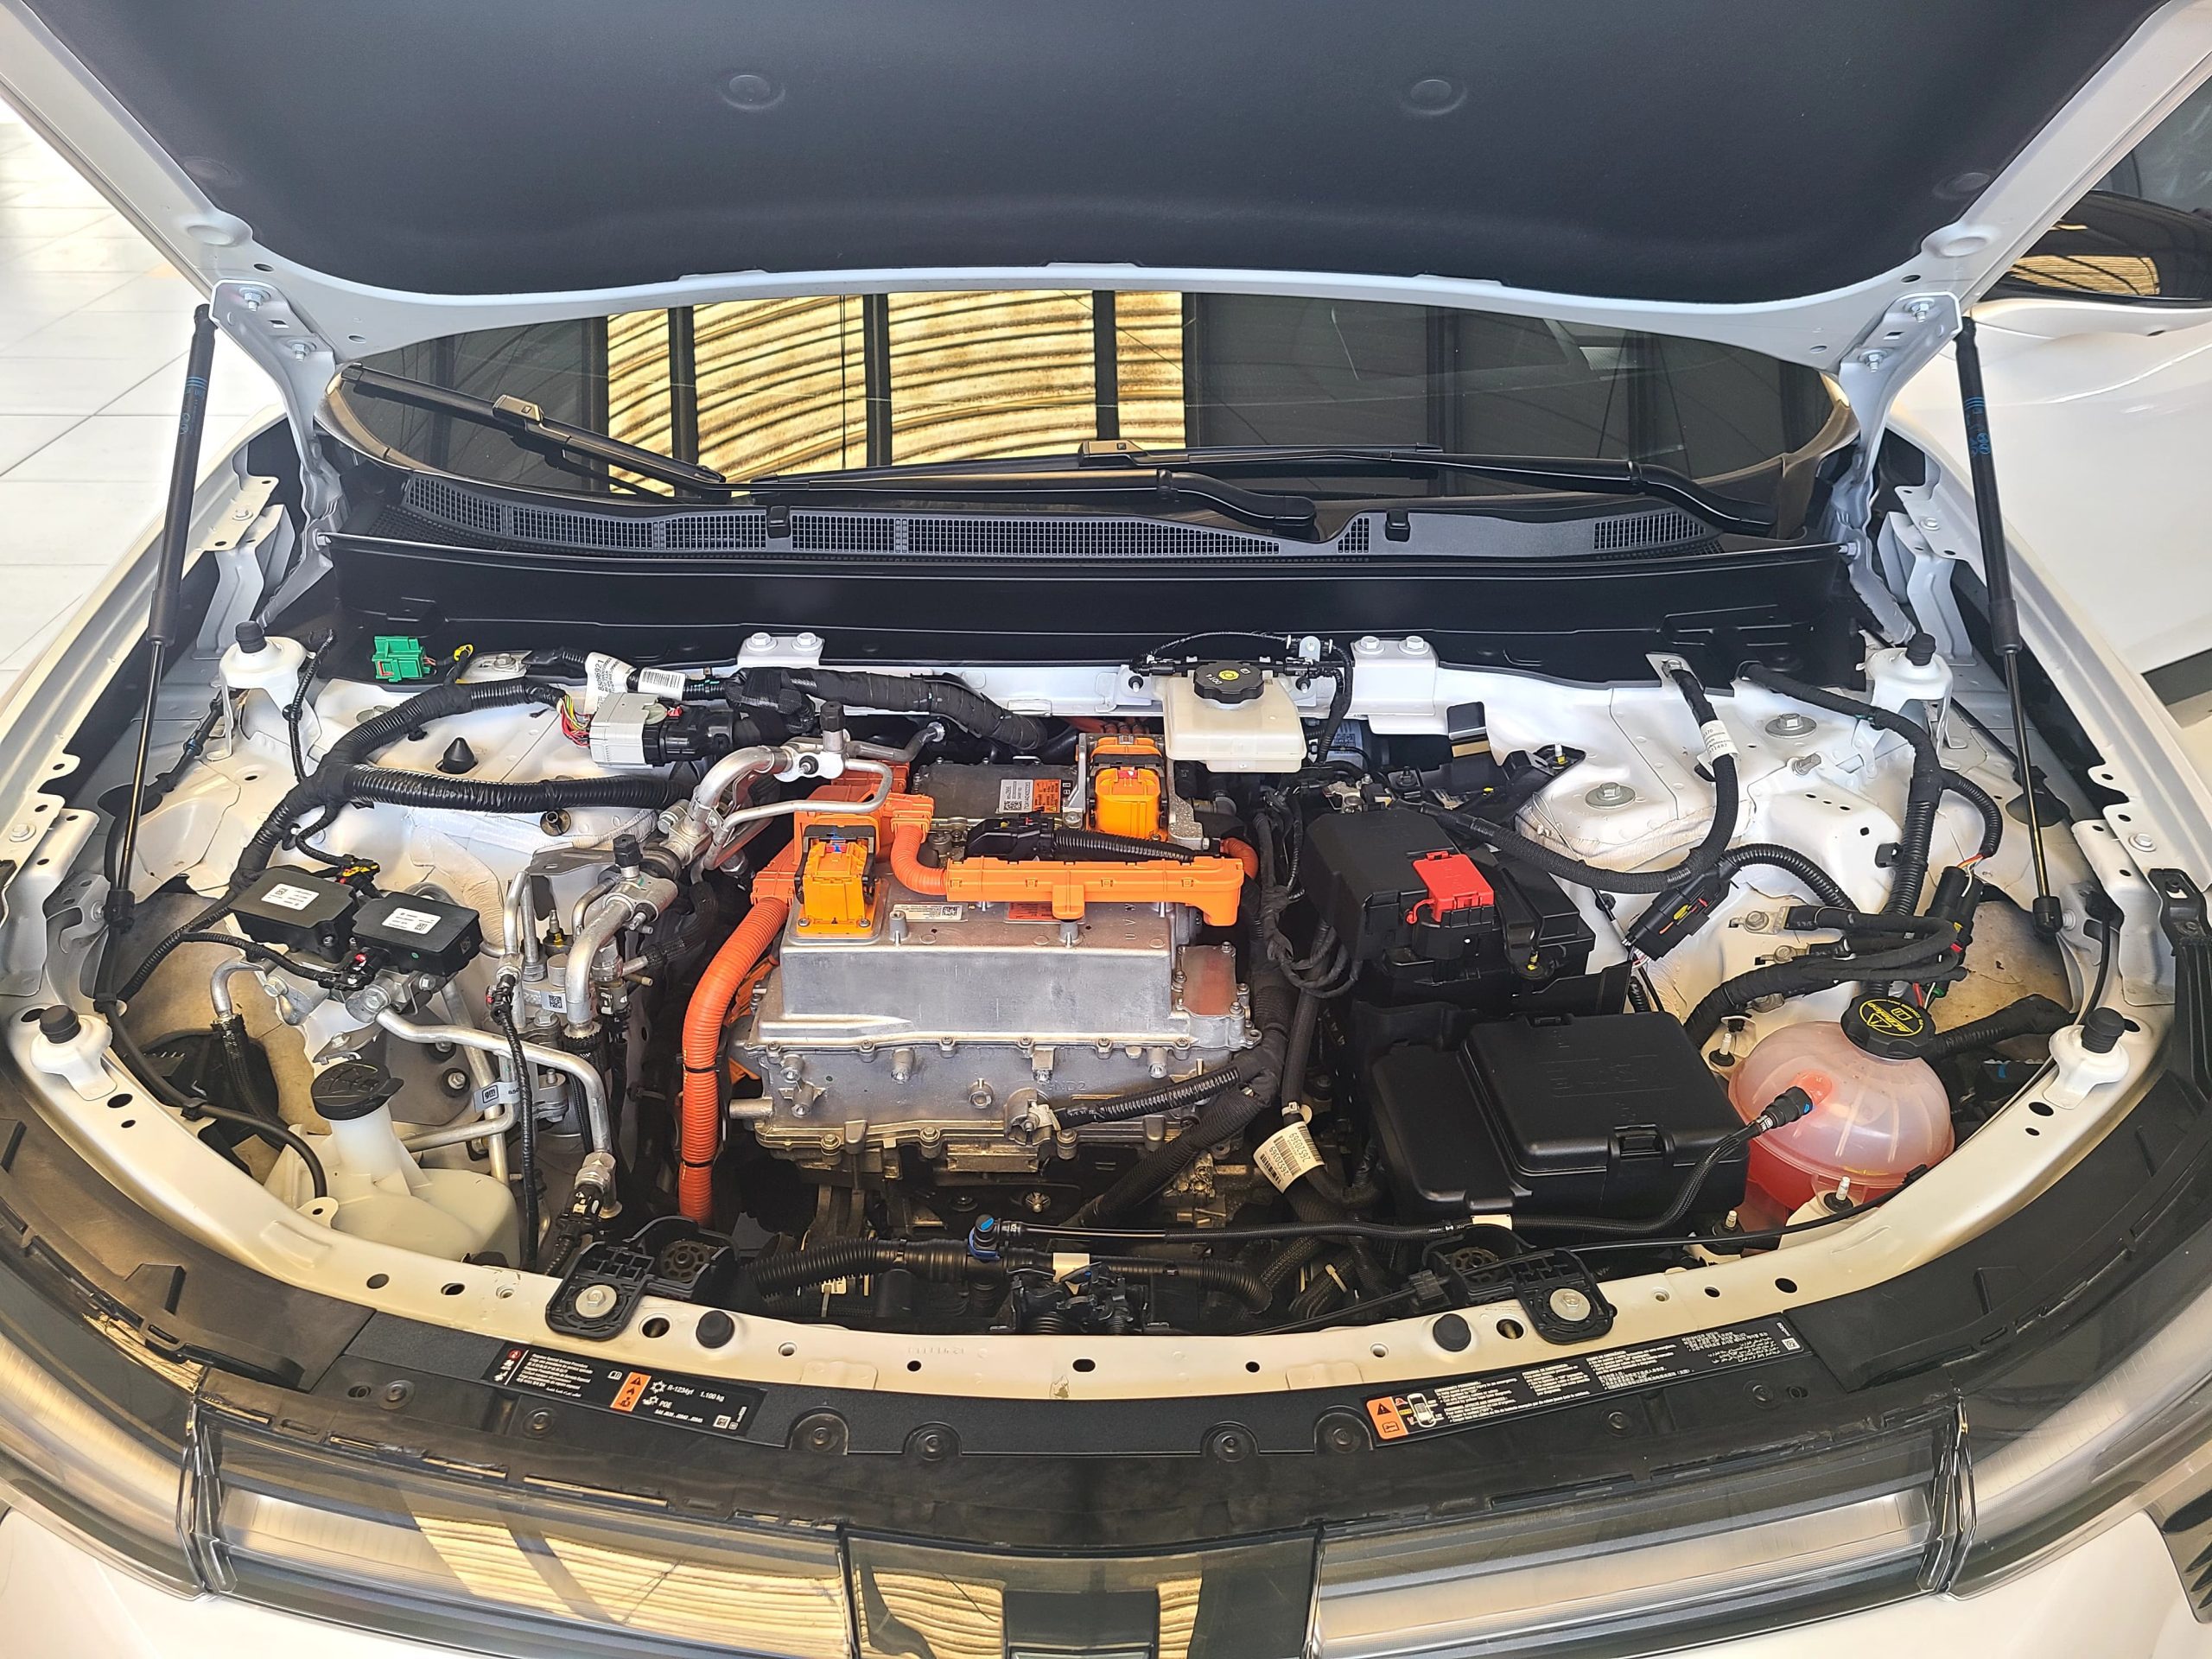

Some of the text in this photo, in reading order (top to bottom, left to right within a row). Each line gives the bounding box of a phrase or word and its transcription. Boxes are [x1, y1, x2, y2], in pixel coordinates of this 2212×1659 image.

[484, 1089, 496, 1099] gm
[1288, 1132, 1311, 1162] 26520369
[1268, 1146, 1289, 1177] 26520369
[667, 1384, 695, 1395] R-1234yf
[659, 1400, 672, 1408] POE
